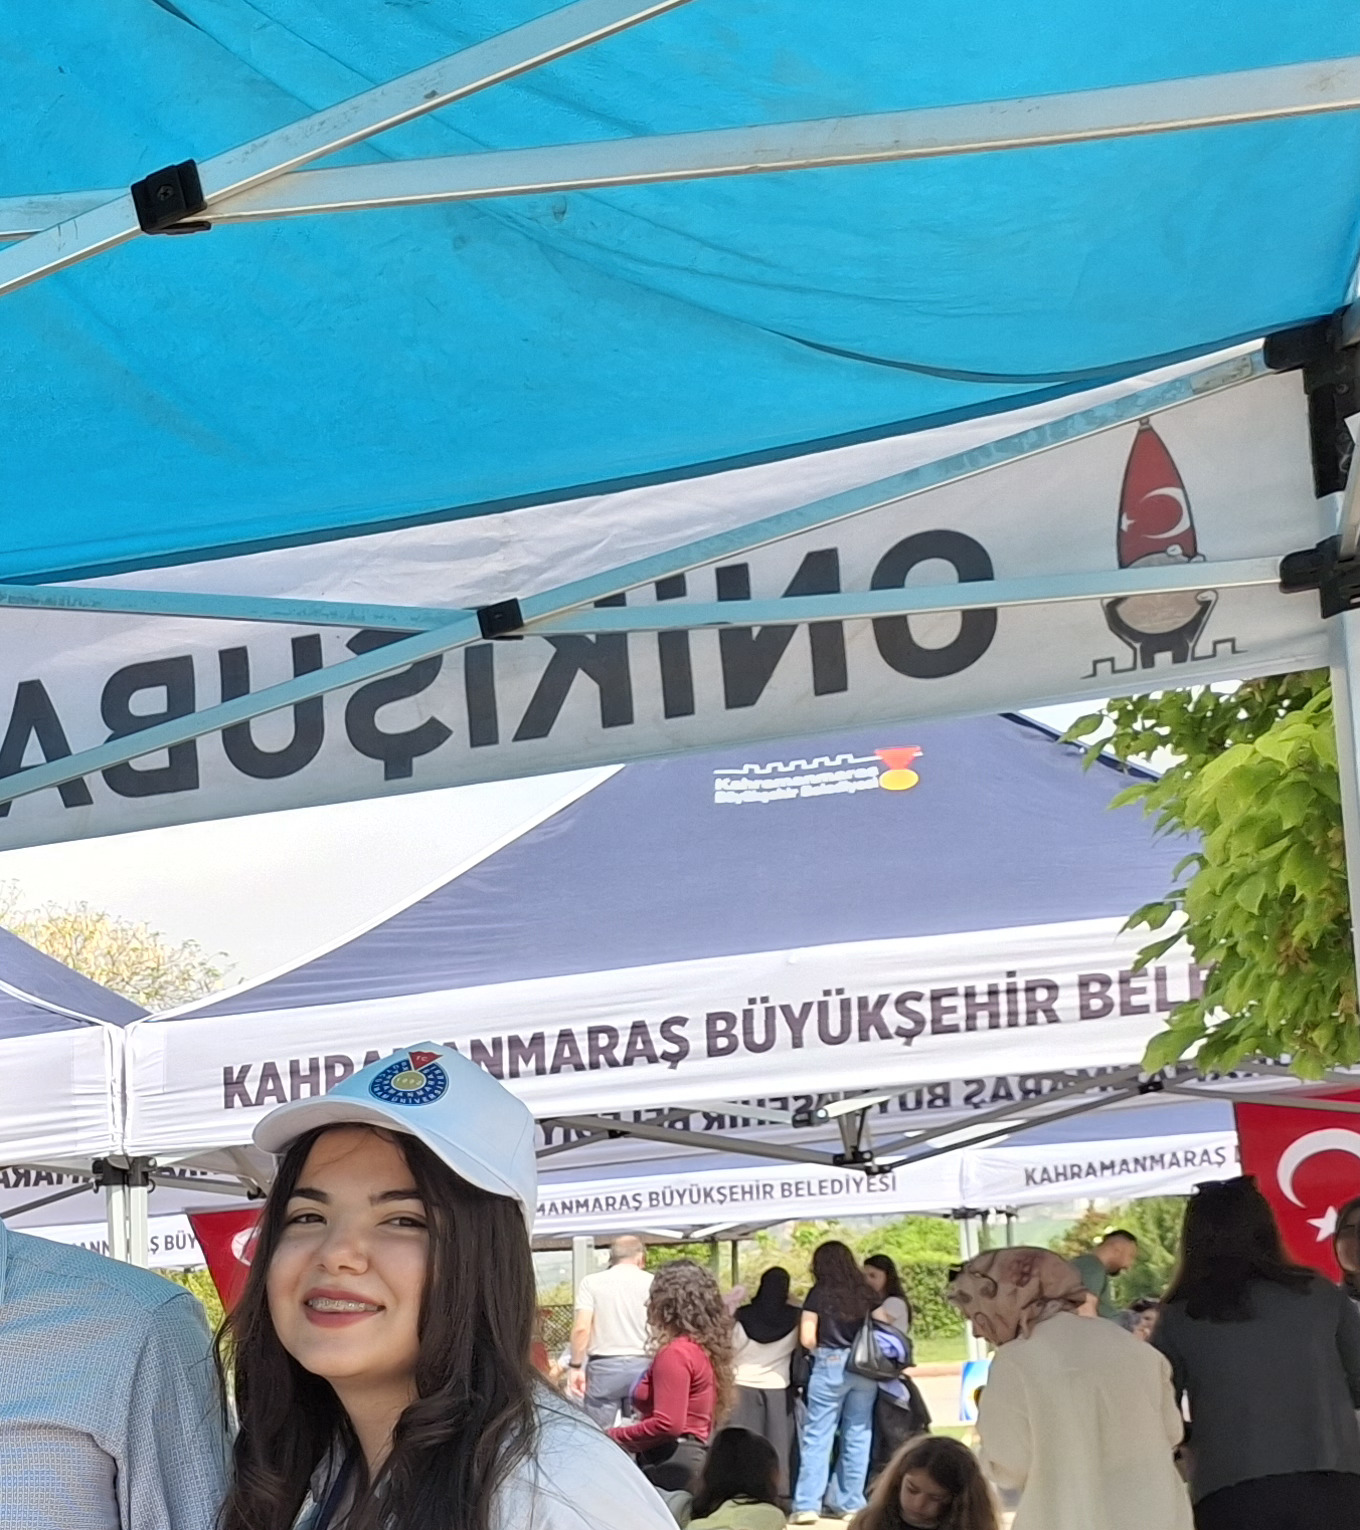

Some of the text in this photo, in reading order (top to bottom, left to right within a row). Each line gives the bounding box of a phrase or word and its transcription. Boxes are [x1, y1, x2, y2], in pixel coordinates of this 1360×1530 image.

[223, 1013, 690, 1110] KAHRNMARAŞ
[706, 970, 1061, 1058] BÜYÜKŞEHİR
[1024, 1145, 1227, 1187] KAHRAMANMARAŞ
[649, 1177, 775, 1207] BÜYÜKŞEHİR
[782, 1172, 897, 1198] BELEDİYESİ
